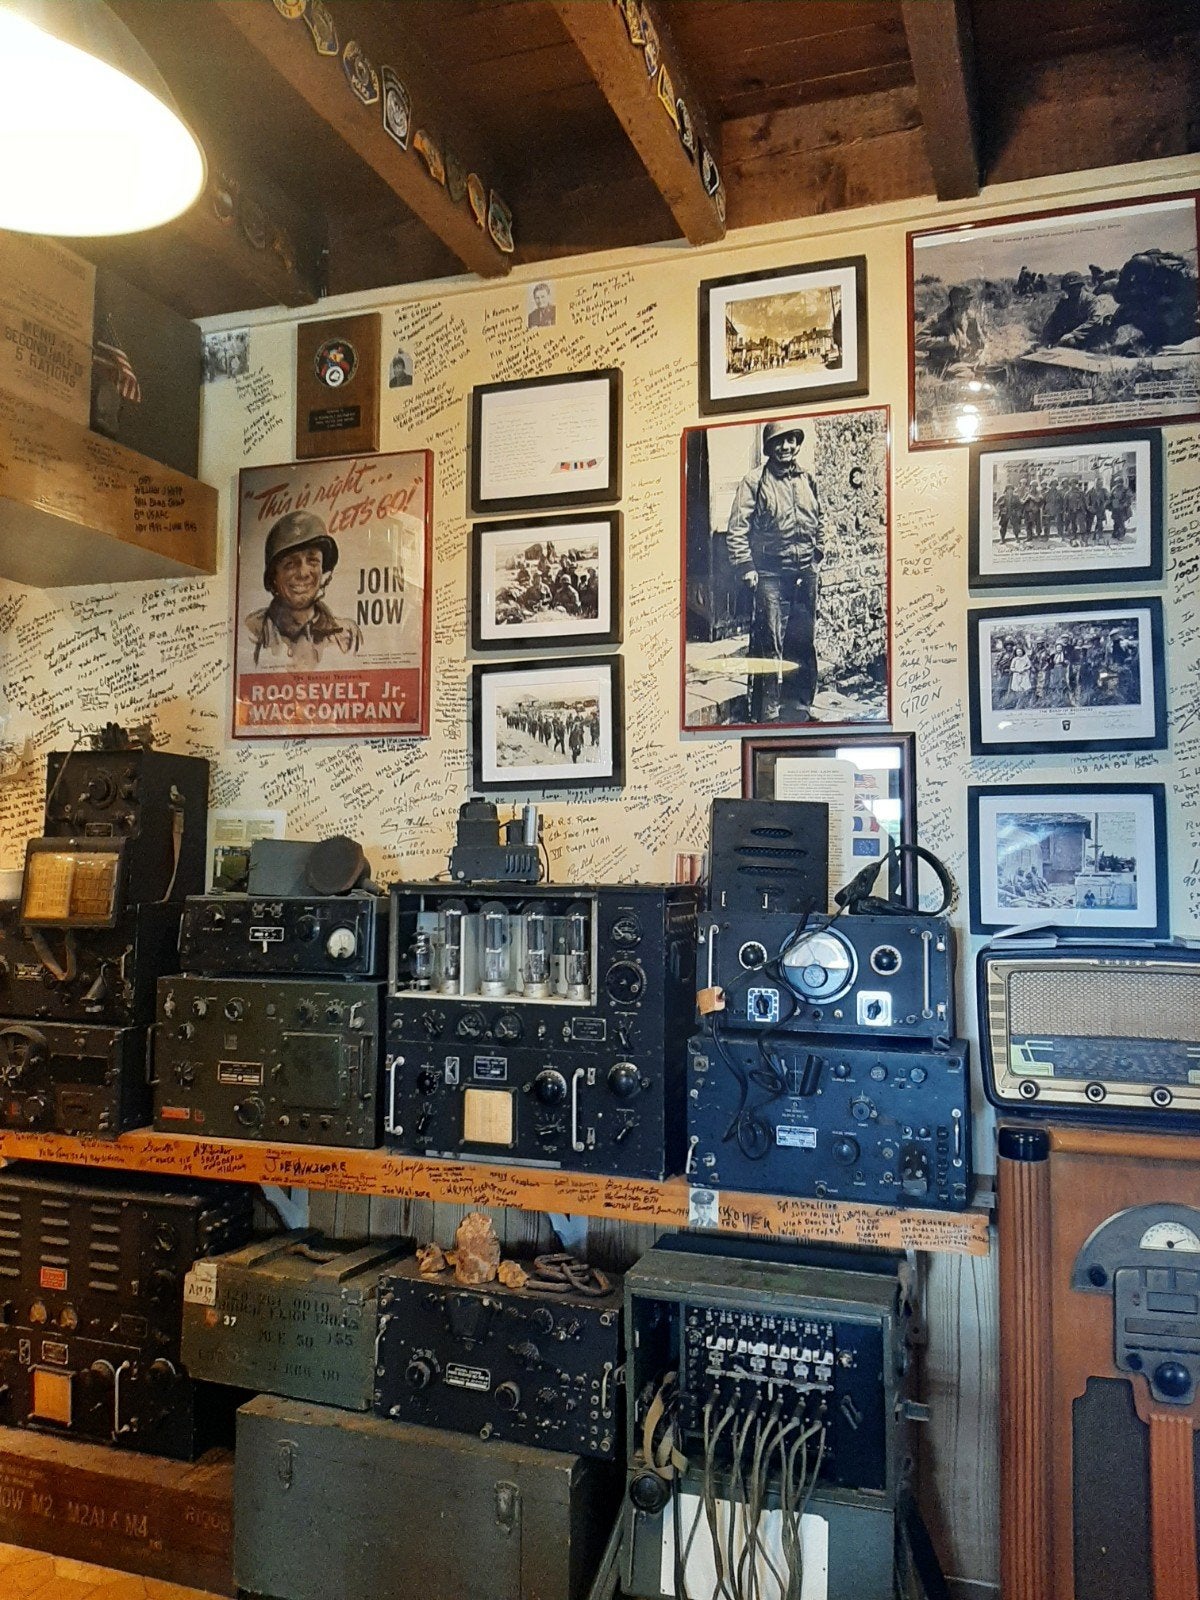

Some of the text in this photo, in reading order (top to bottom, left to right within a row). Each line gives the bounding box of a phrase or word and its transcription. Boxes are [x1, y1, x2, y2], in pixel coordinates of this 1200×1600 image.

[15, 345, 77, 388] 5 RATIONS
[297, 483, 311, 509] is
[357, 566, 405, 595] JOIN
[356, 598, 404, 626] NOW
[895, 666, 931, 688] GOLD
[251, 681, 407, 701] ROOSEVELT Jr.
[251, 700, 406, 722] WAC COMPANY
[325, 758, 344, 773] UTAH
[375, 764, 393, 777] HMS
[590, 835, 611, 848] UTAH
[223, 1314, 238, 1327] 37
